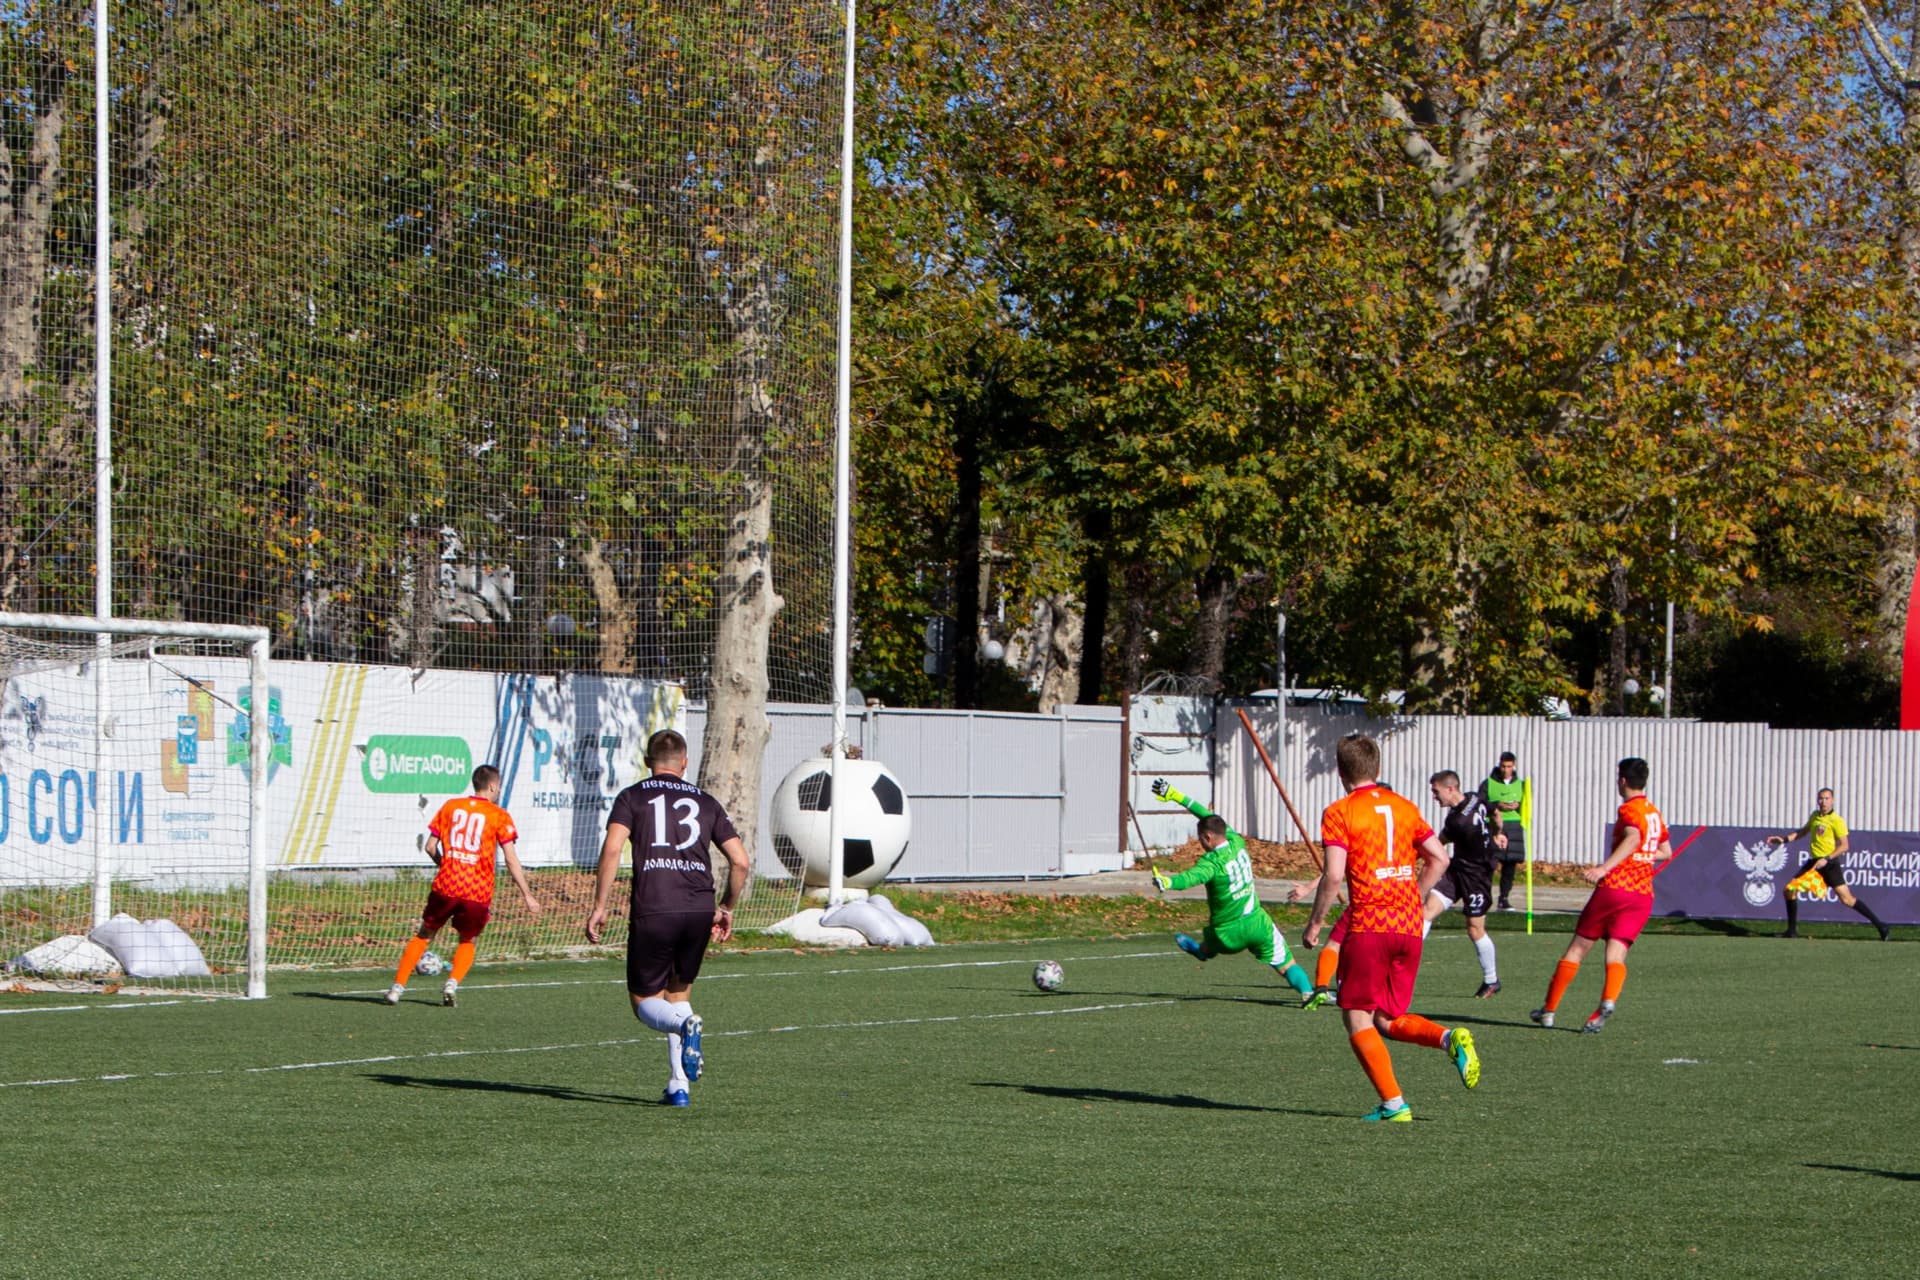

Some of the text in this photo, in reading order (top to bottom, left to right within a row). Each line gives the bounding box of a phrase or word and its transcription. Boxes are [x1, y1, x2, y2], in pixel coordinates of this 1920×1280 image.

[532, 792, 618, 812] НЕДВИЖИМОСТ
[450, 808, 486, 853] 20
[647, 793, 701, 851] 13
[1798, 850, 1920, 870] РИЙСКИЙ
[1469, 893, 1485, 907] 23
